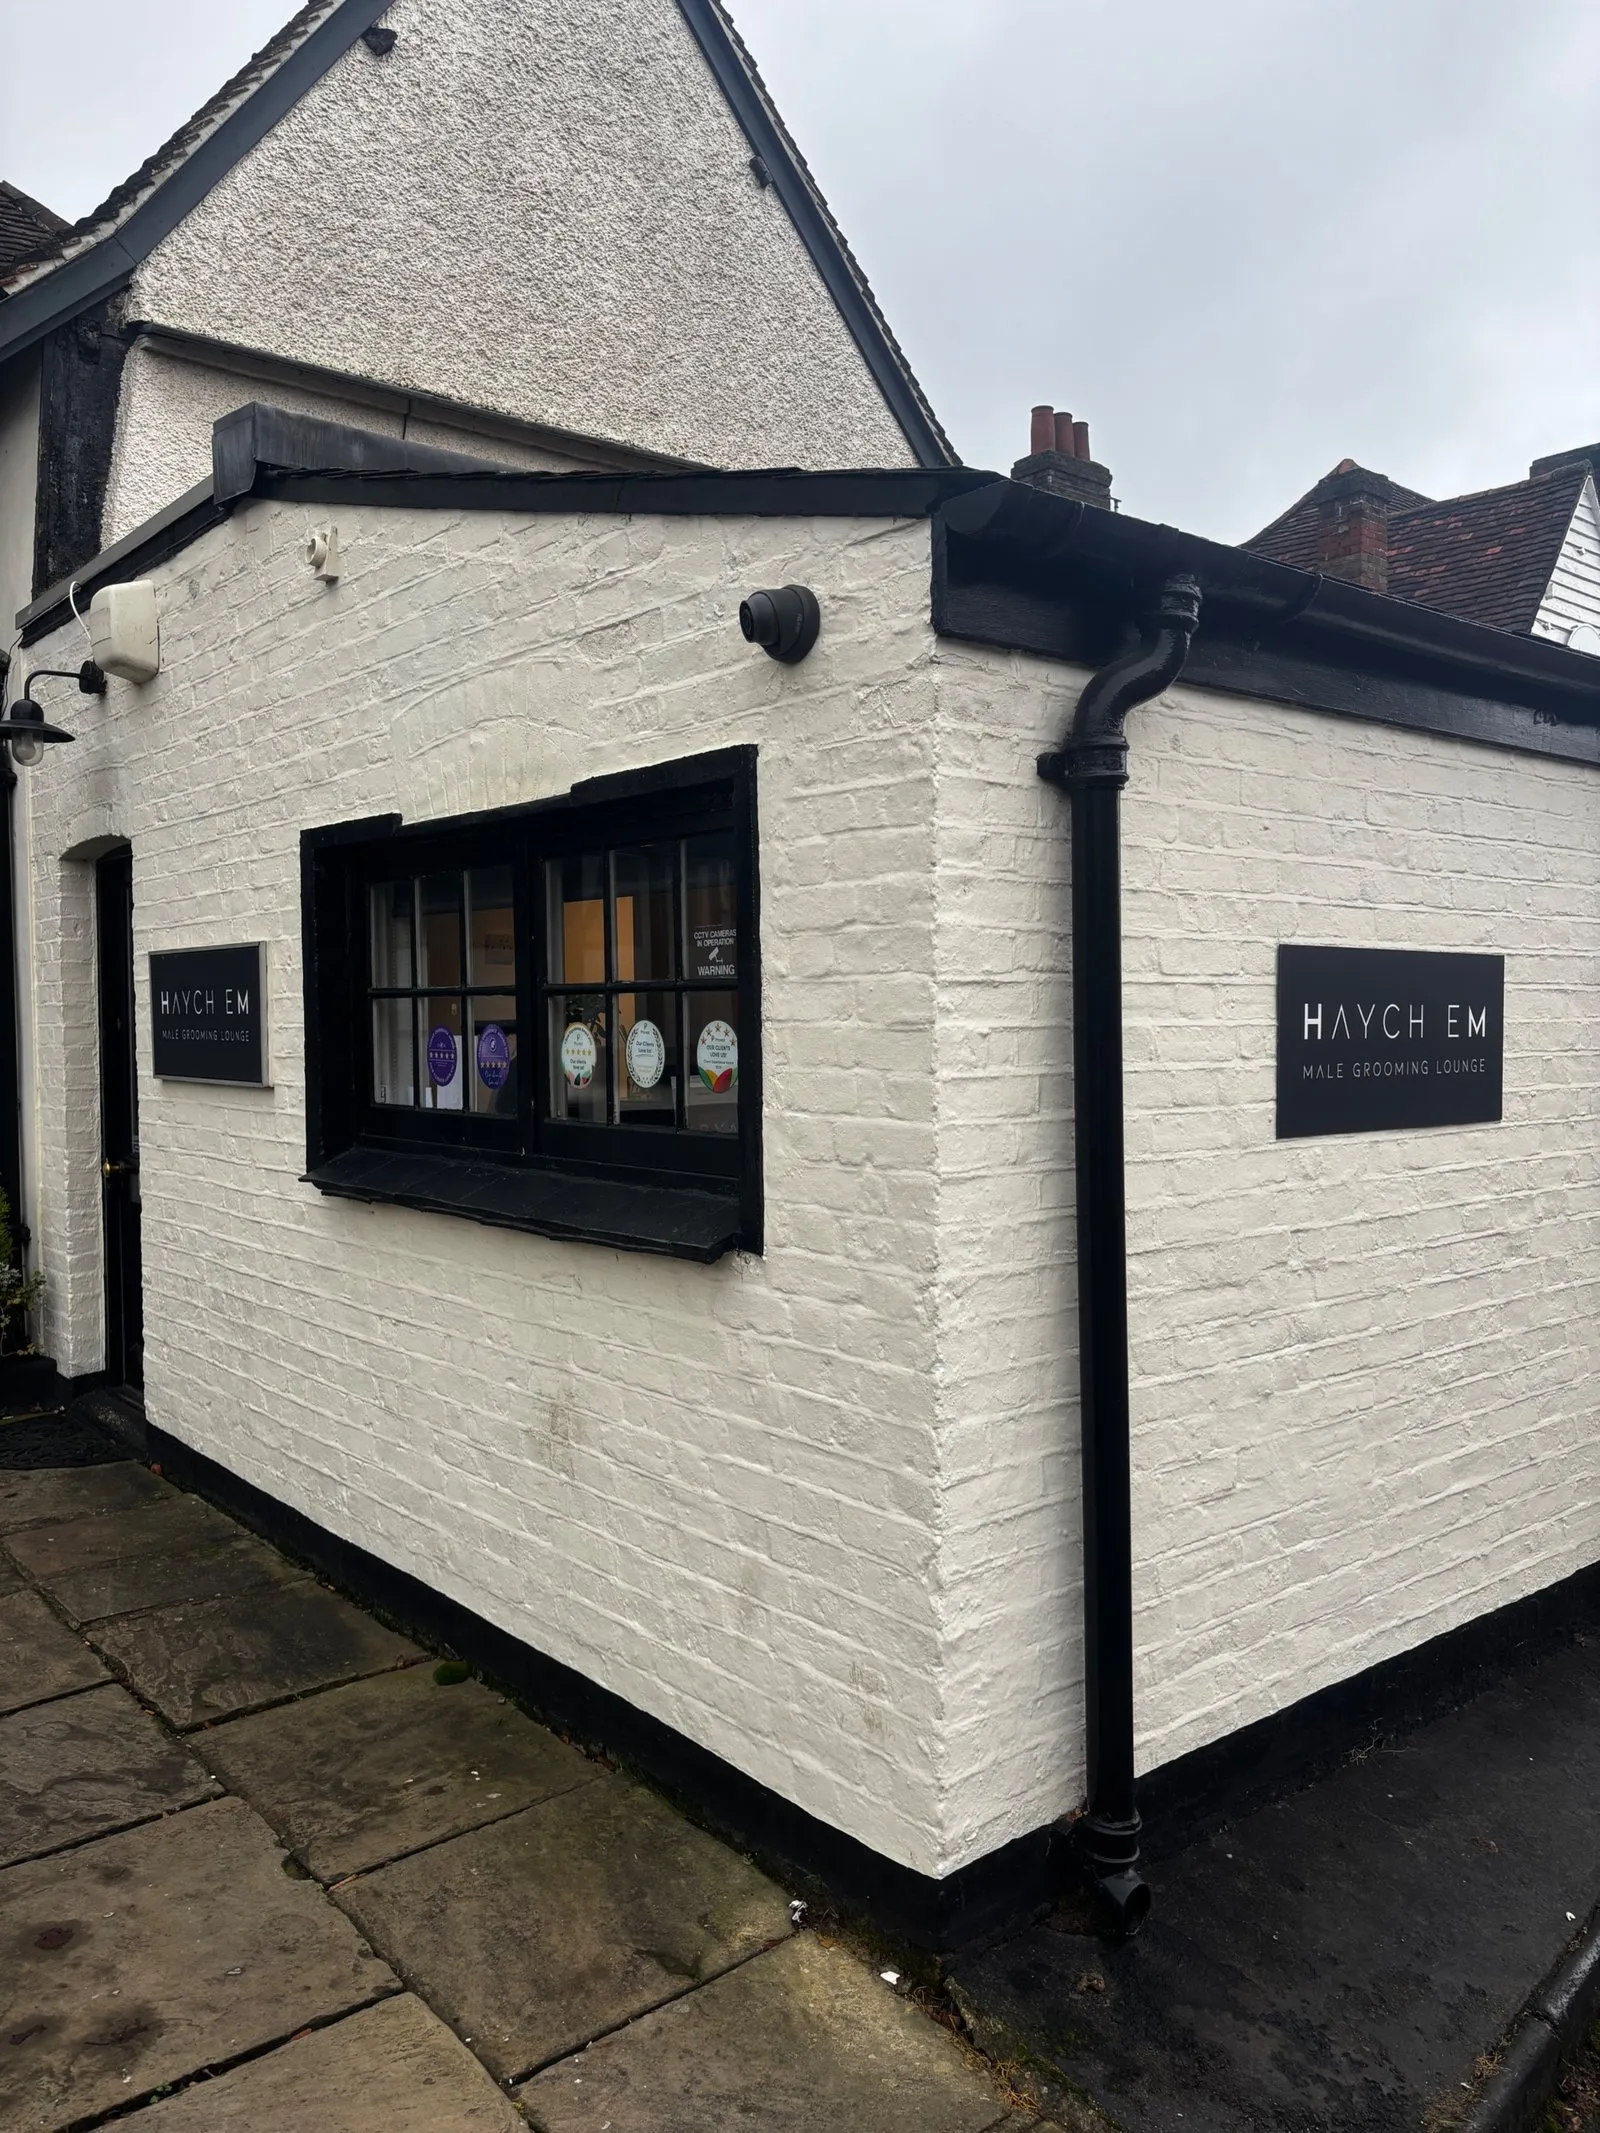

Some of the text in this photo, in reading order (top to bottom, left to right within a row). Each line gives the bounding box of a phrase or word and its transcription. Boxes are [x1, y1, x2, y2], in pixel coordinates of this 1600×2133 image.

[694, 929, 736, 940] CCTV CAMERAS
[703, 938, 734, 947] OPERATION
[697, 964, 735, 976] WARNING
[161, 989, 248, 1014] HAYCH EM
[1304, 1003, 1486, 1040] HAYCH EM
[162, 1029, 249, 1041] MALE GROOMING LOUNGE
[1303, 1059, 1485, 1079] MALE GROOMING LOUNGE
